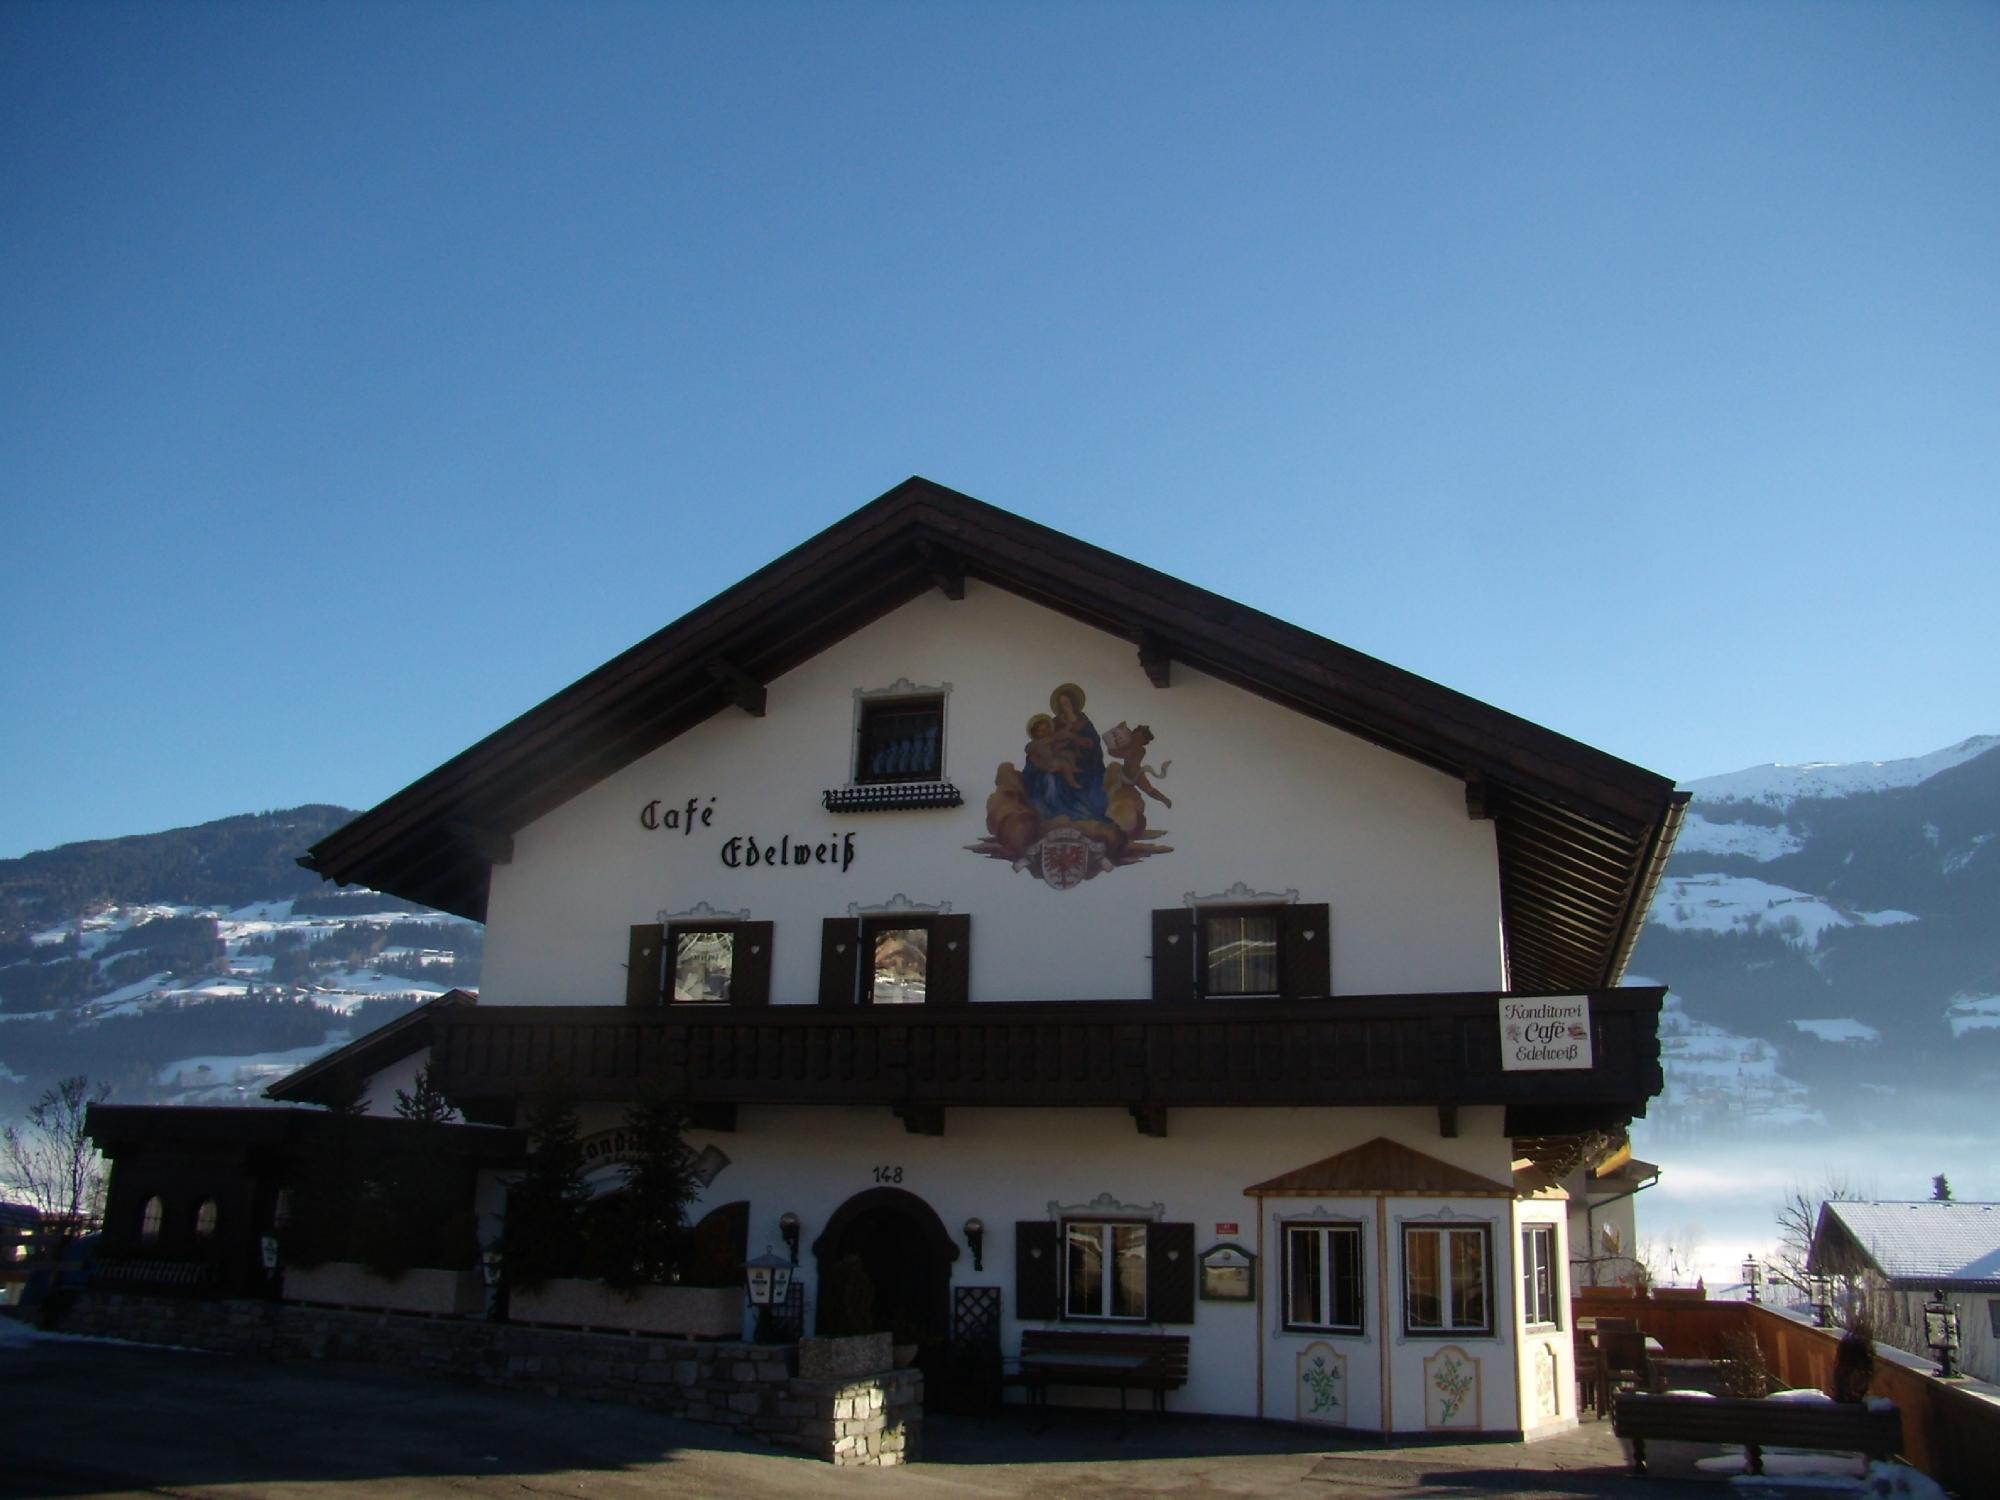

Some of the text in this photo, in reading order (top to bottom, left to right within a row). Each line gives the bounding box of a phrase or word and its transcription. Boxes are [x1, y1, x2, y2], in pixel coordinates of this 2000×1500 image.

[641, 796, 716, 835] Café
[721, 832, 856, 872] Edelweiß
[1505, 1004, 1582, 1020] Konditorei
[1525, 1021, 1565, 1044] Café
[1516, 1044, 1578, 1061] Edelweiß
[872, 1165, 903, 1184] 148
